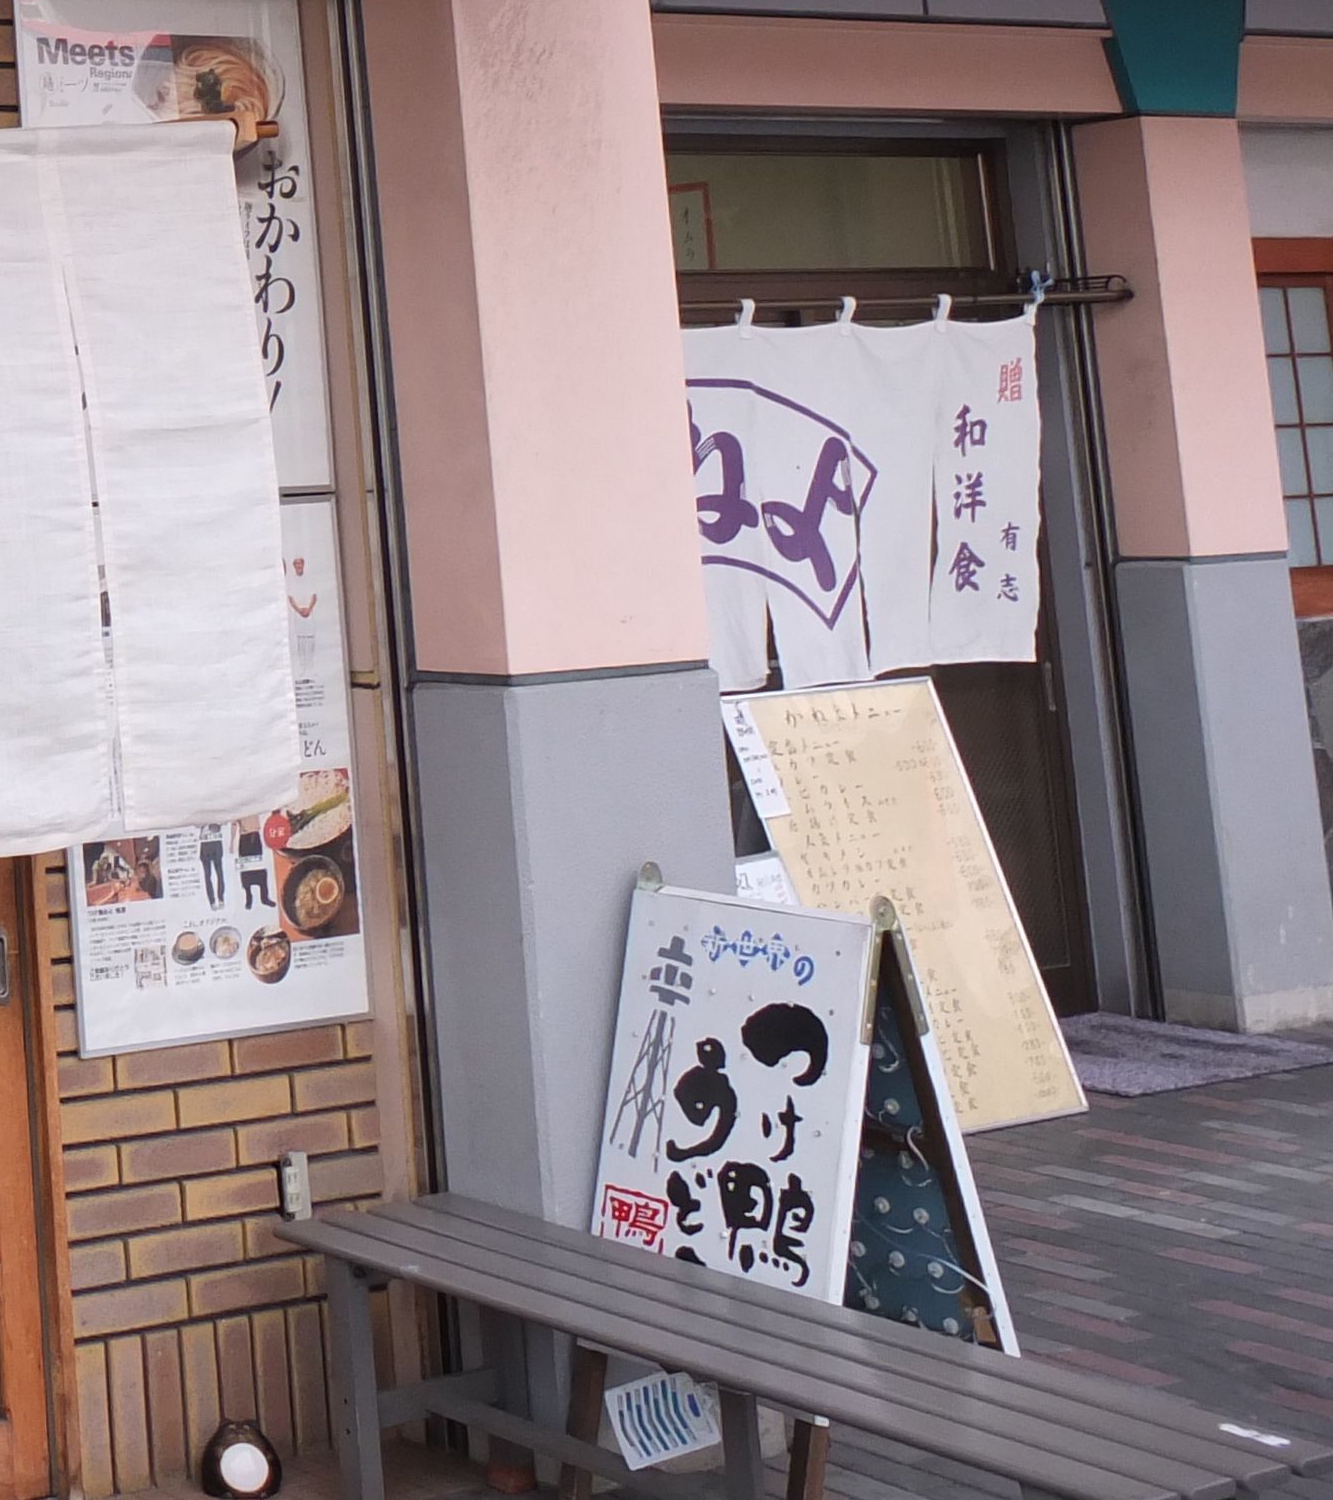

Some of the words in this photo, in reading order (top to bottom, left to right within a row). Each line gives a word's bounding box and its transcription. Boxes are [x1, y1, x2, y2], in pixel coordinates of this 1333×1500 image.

[36, 36, 136, 68] Meets
[997, 357, 1024, 404] 贈
[948, 403, 988, 593] 和洋食
[996, 521, 1021, 603] 有志
[717, 1001, 830, 1288] つけ鴨
[609, 1195, 665, 1247] 鴨
